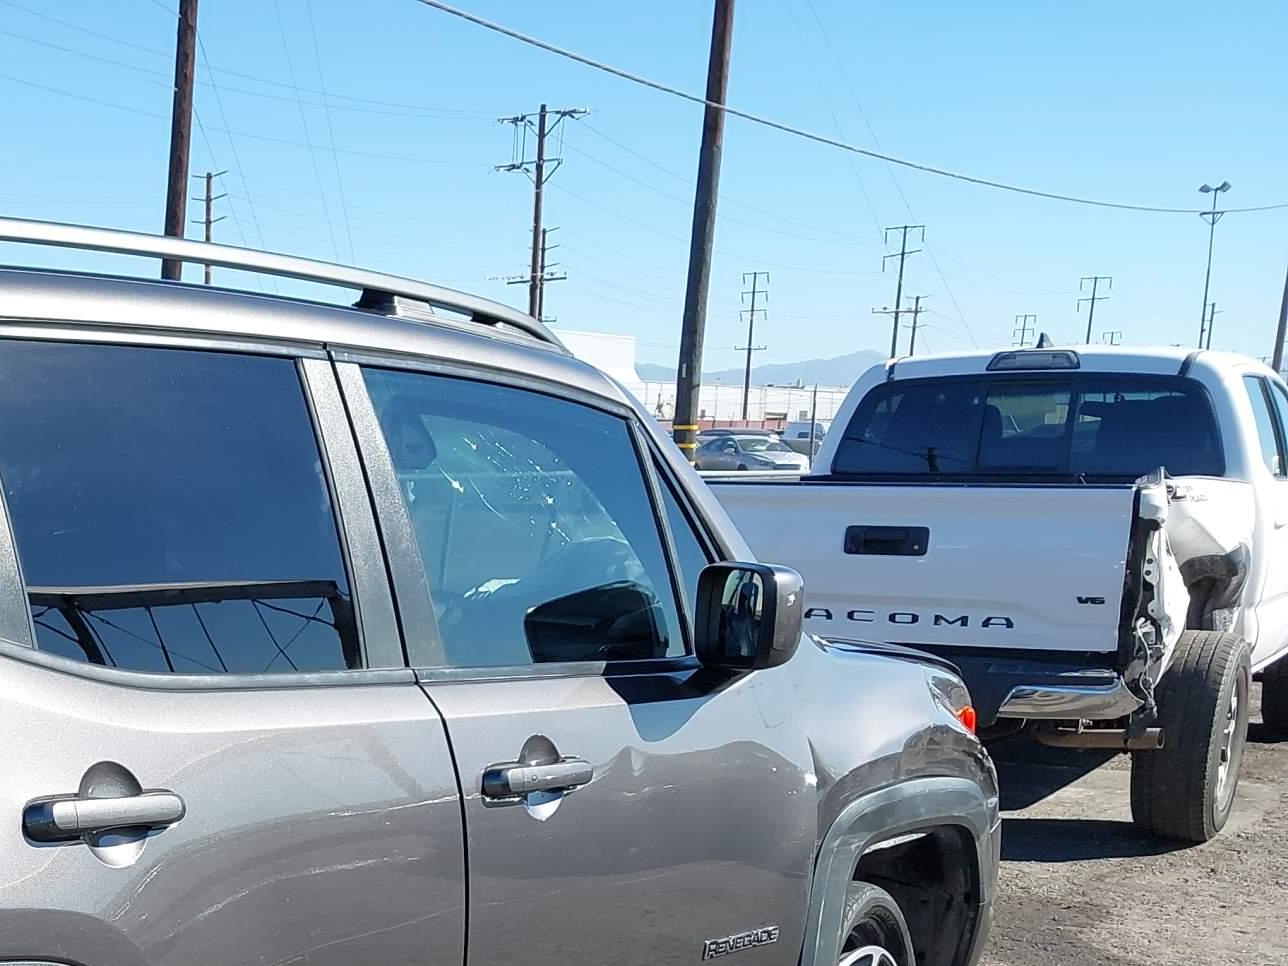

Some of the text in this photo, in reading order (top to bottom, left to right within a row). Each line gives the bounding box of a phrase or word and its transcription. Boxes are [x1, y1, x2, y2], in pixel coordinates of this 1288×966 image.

[1076, 596, 1106, 605] V6
[804, 607, 1015, 629] ACOMA
[703, 925, 780, 960] RENEGADE
